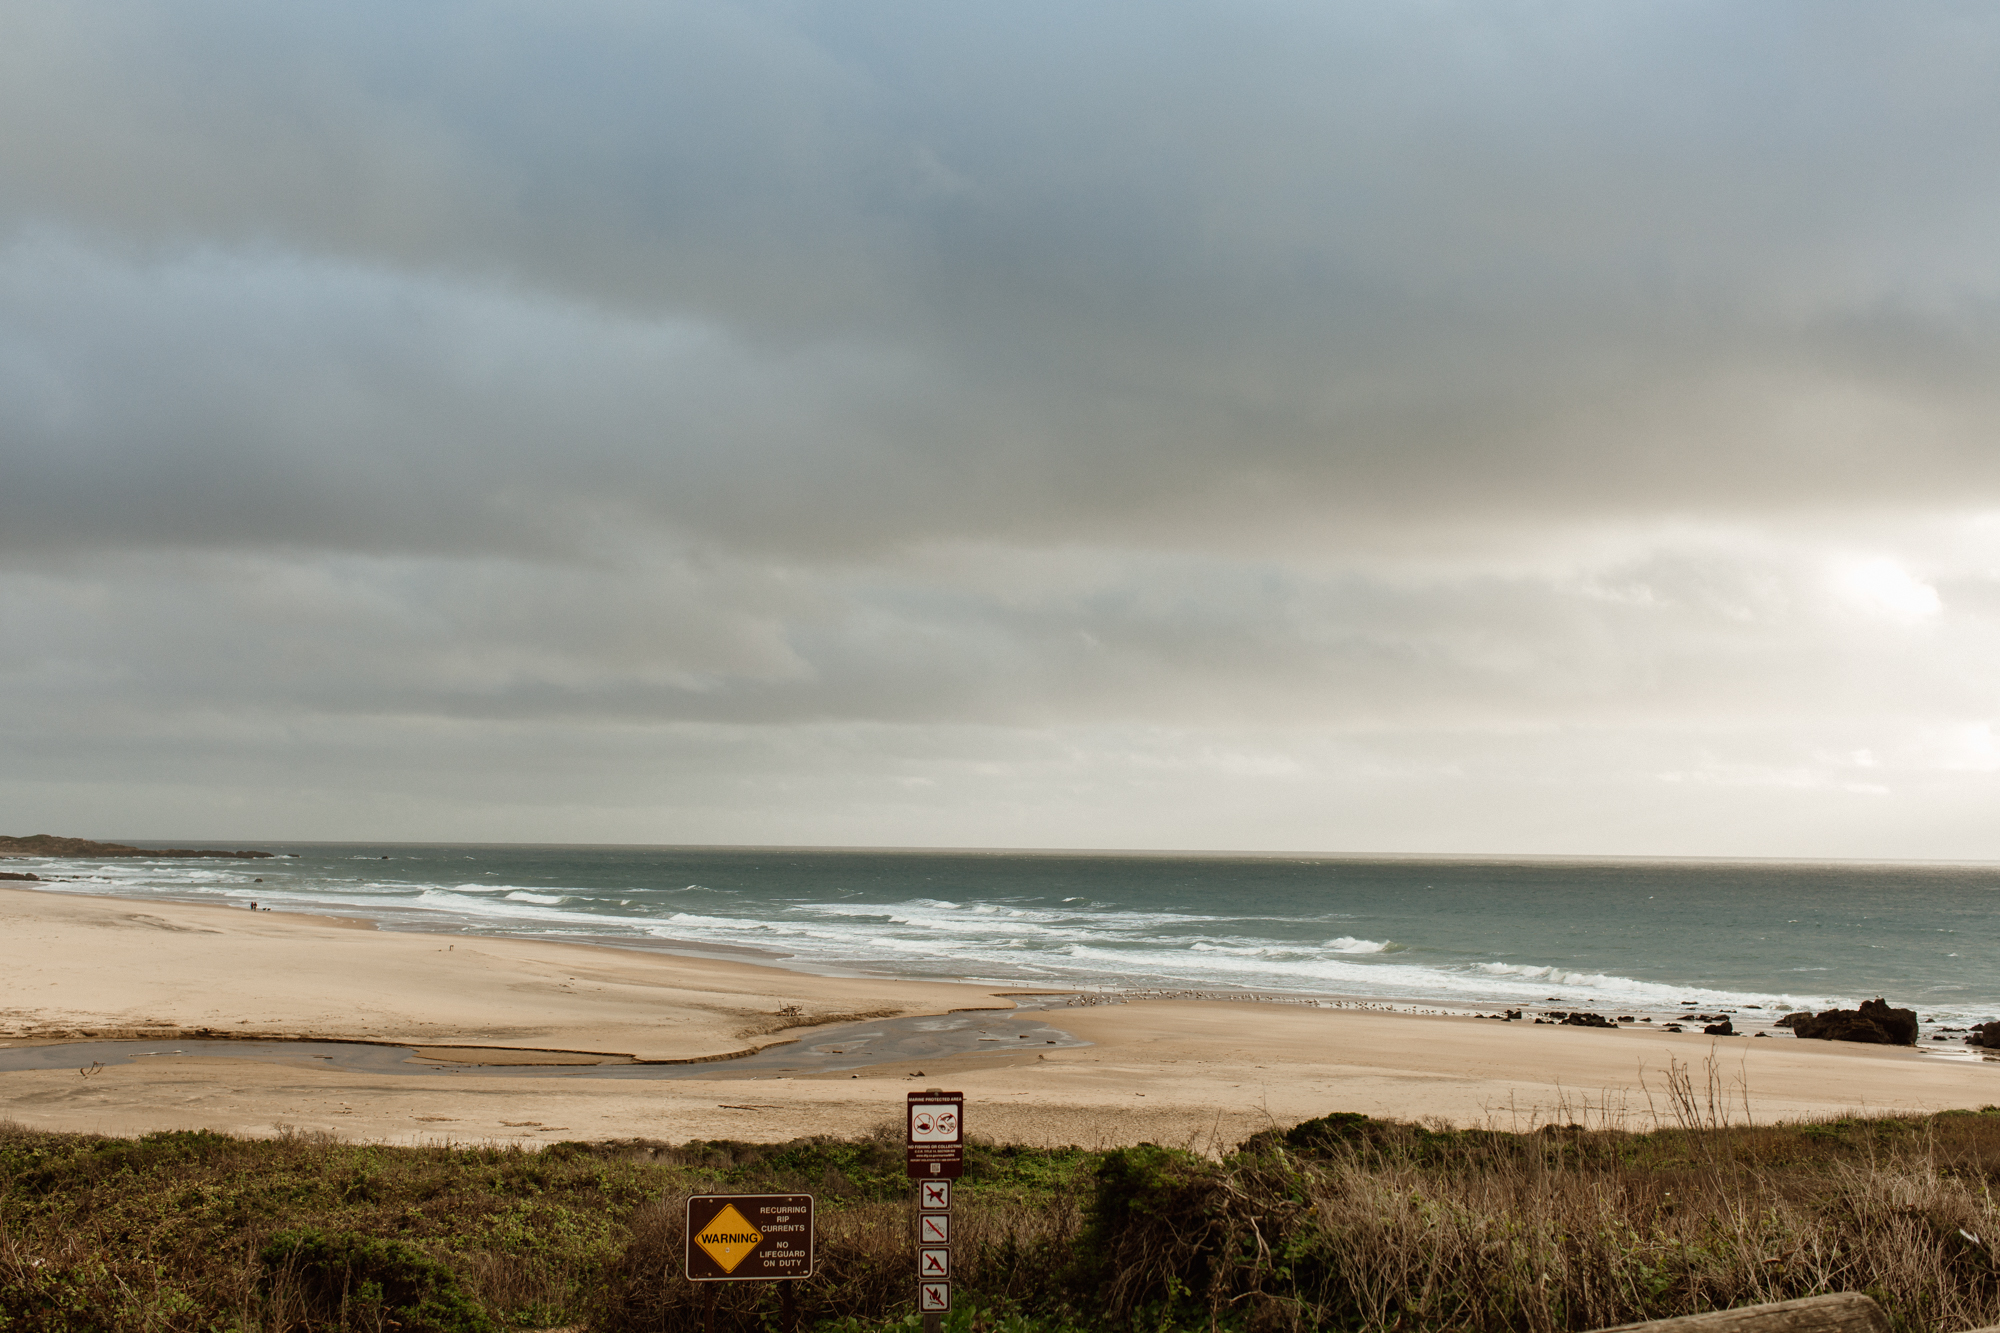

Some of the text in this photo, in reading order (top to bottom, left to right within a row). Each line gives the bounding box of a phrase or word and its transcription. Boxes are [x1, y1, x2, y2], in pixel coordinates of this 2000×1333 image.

[760, 1206, 807, 1214] RECURRING
[776, 1215, 789, 1223] RIP
[761, 1224, 805, 1232] CURRENTS
[701, 1233, 758, 1244] WARNING
[759, 1250, 805, 1258] LIFEGUARD
[779, 1259, 802, 1267] DUTY
